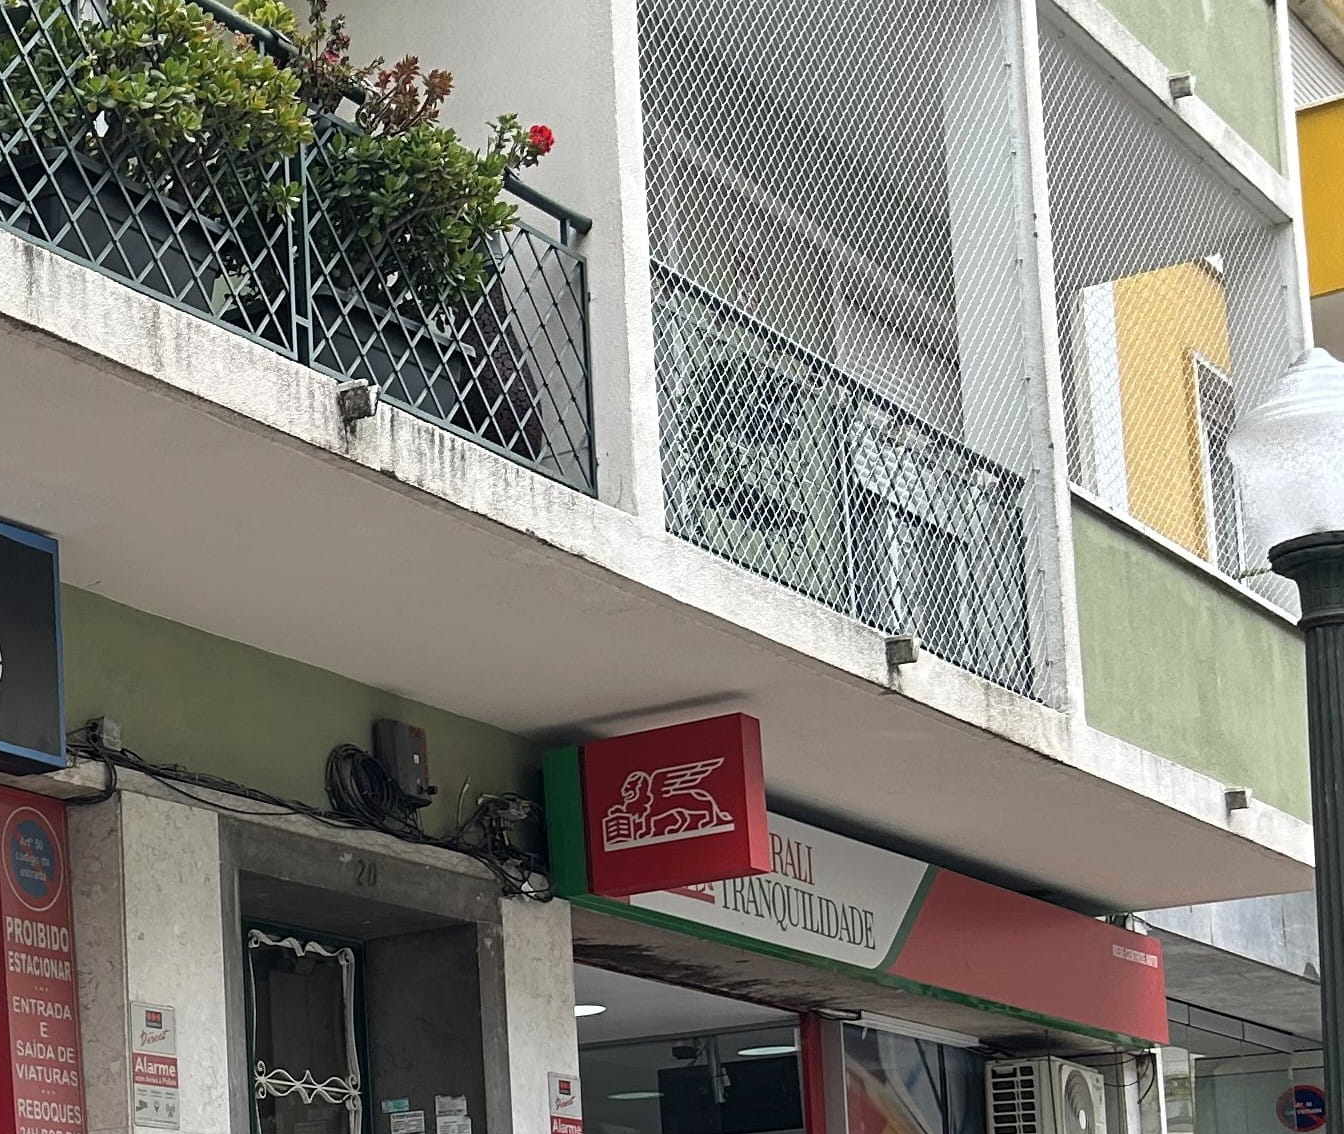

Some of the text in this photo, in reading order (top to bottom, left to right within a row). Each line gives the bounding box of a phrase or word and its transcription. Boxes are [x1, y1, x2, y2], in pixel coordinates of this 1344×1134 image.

[356, 857, 377, 887] 20
[769, 832, 815, 886] RALI
[722, 873, 876, 950] TRANQUILIDADE
[6, 915, 69, 953] PROIBIDO
[8, 951, 72, 982] ESTACIONAR
[13, 996, 73, 1021] ENTRADA
[39, 1021, 49, 1038] E
[16, 1037, 75, 1064] SAÍDA DE
[16, 1063, 78, 1087] VIATURAS
[135, 1056, 176, 1077] Alarme
[18, 1098, 82, 1126] REBOQUES
